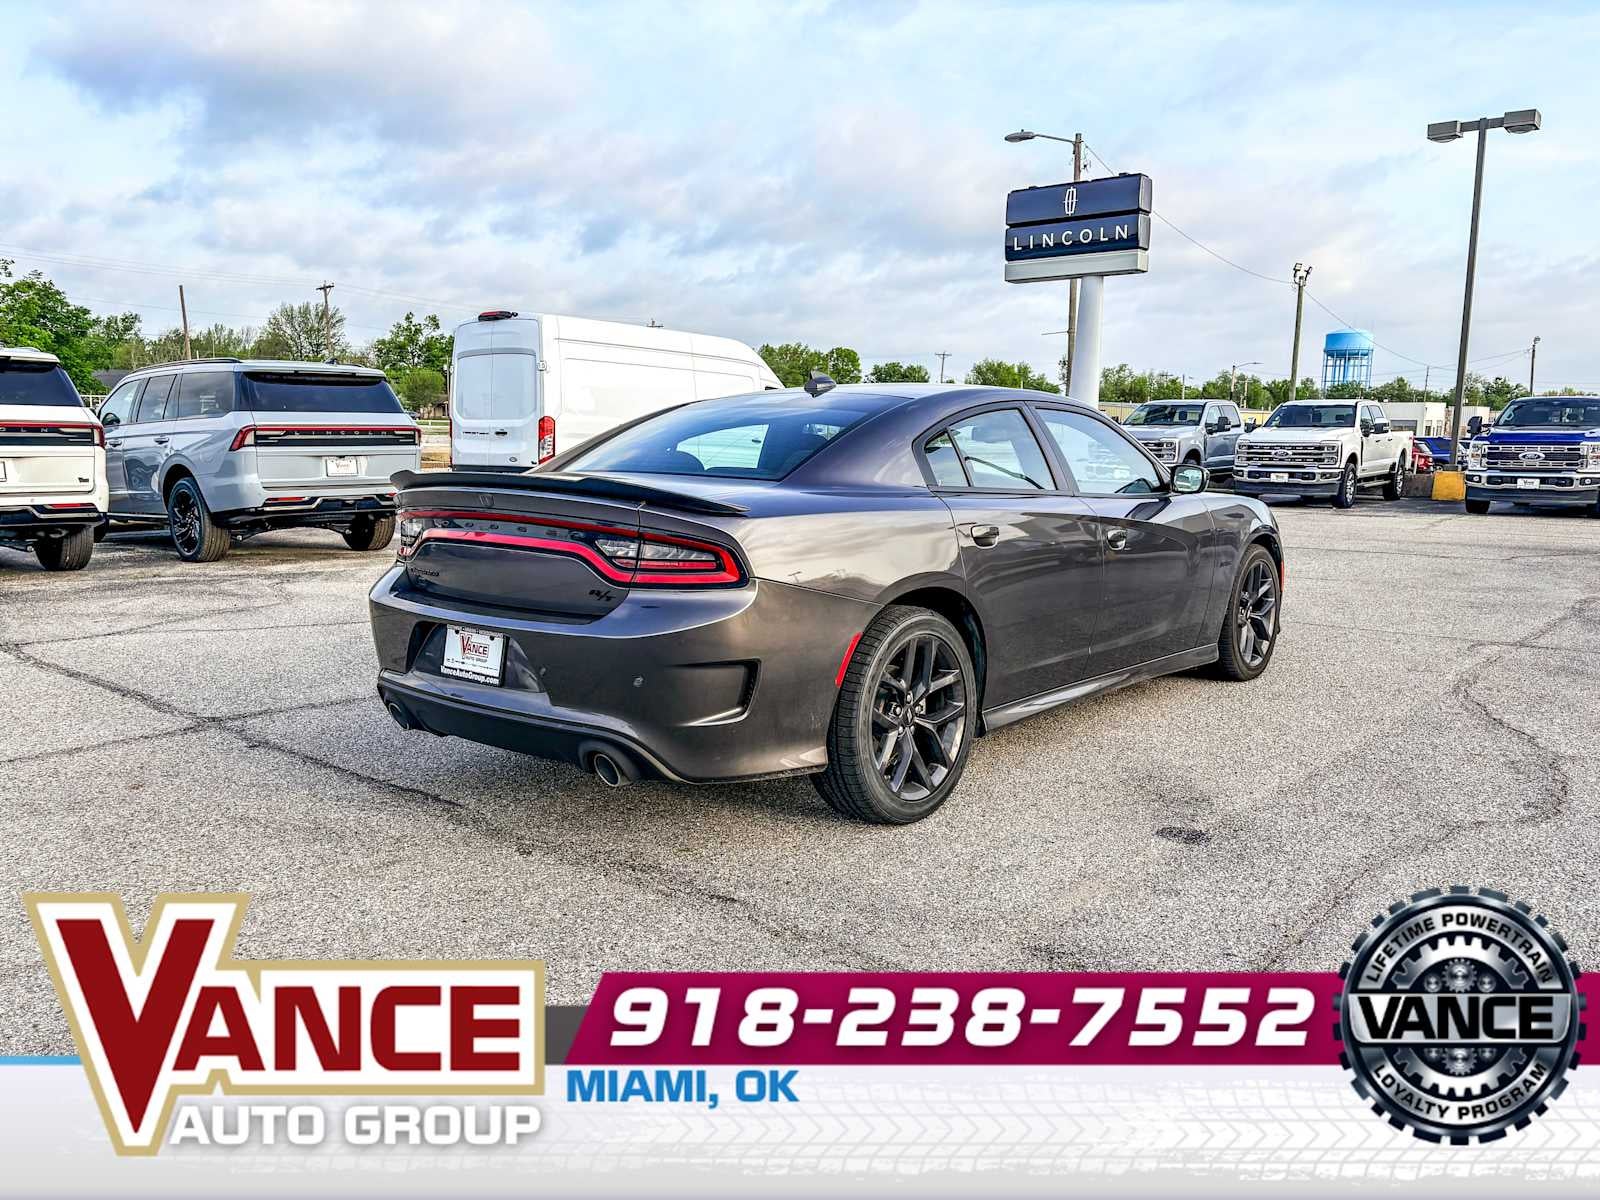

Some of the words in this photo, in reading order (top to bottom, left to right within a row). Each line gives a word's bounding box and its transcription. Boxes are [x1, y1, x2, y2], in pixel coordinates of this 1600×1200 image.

[1013, 224, 1129, 251] LINCOLN
[460, 634, 488, 656] VANCE
[440, 664, 500, 685] VanceAutoGroup.com
